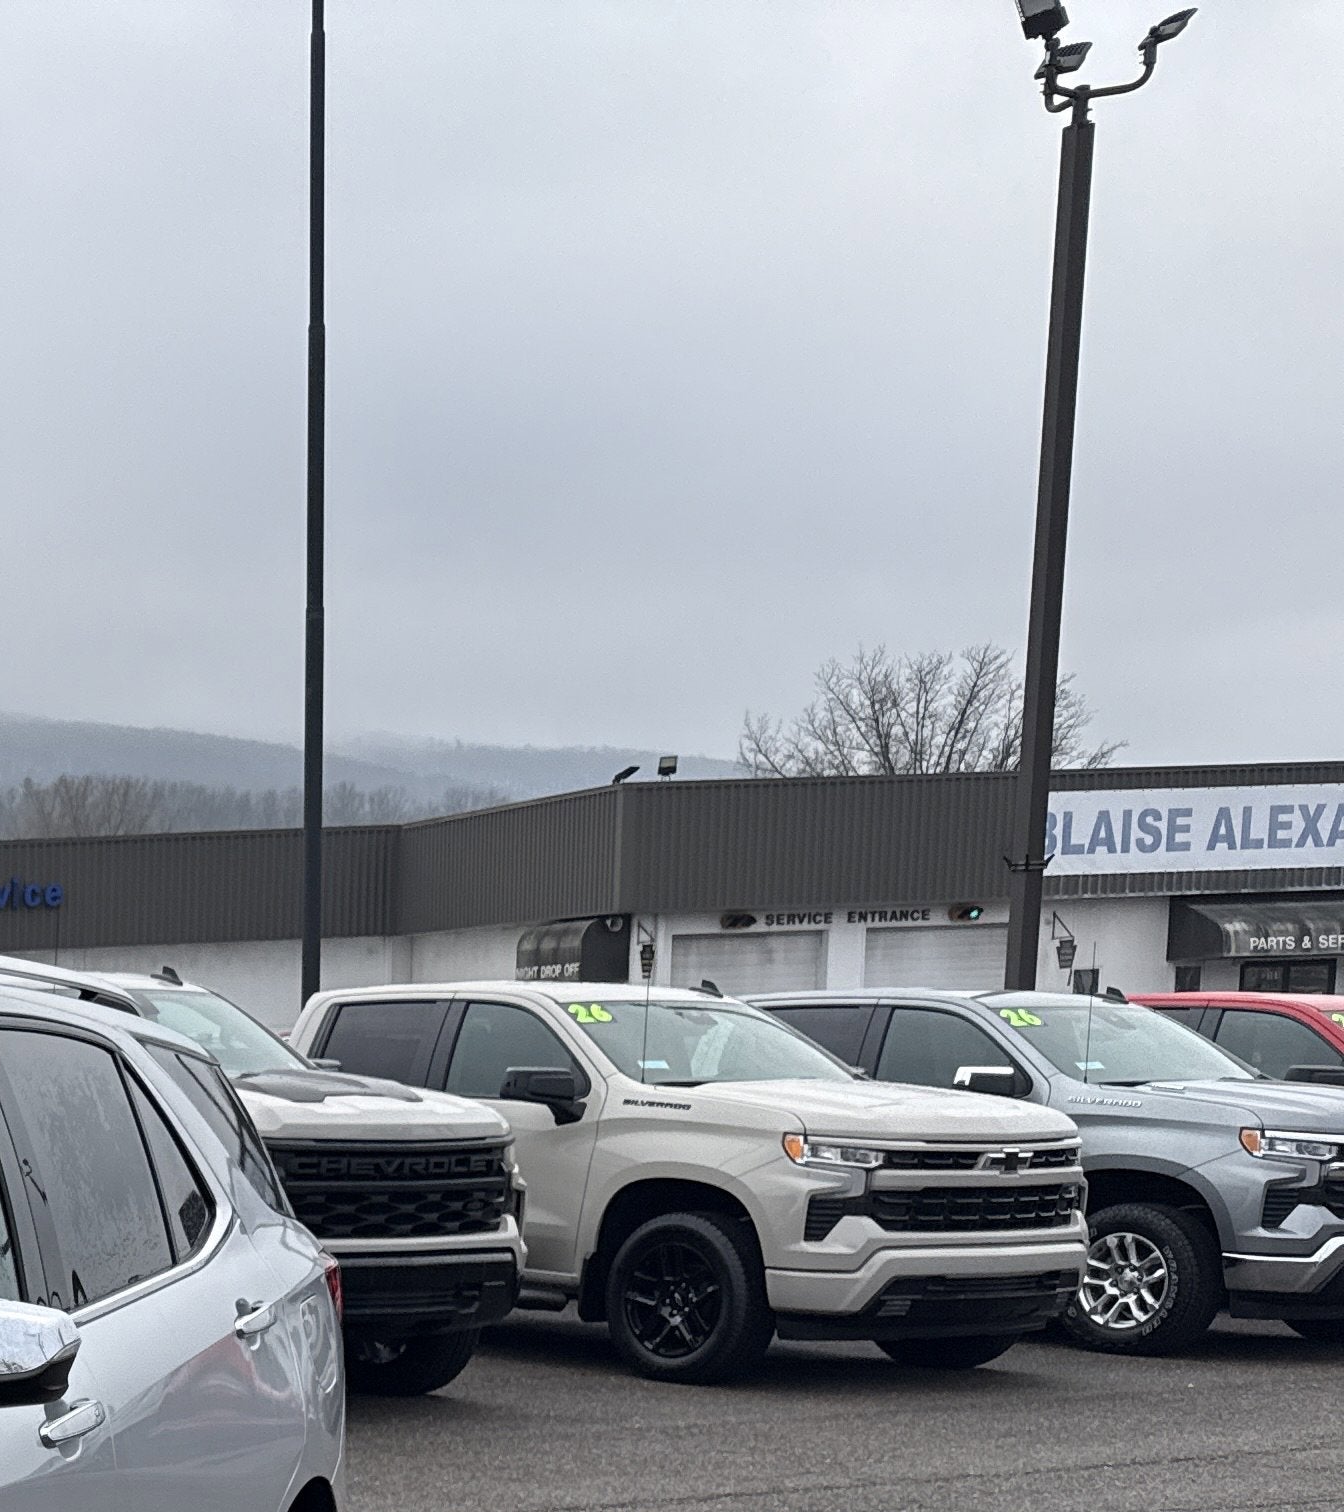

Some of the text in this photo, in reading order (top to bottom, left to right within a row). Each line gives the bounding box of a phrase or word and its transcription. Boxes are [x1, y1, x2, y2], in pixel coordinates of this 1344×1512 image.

[1206, 802, 1344, 850] ALEXA
[765, 908, 931, 927] SERVICE ENTRANCE
[1250, 936, 1296, 951] PARTS
[1301, 935, 1312, 949] &
[540, 963, 562, 978] DROP
[563, 961, 581, 977] OFF
[568, 1003, 613, 1024] 26
[999, 1008, 1042, 1027] 26
[622, 1098, 692, 1111] SILVERADO
[1067, 1095, 1143, 1109] SILVERADO
